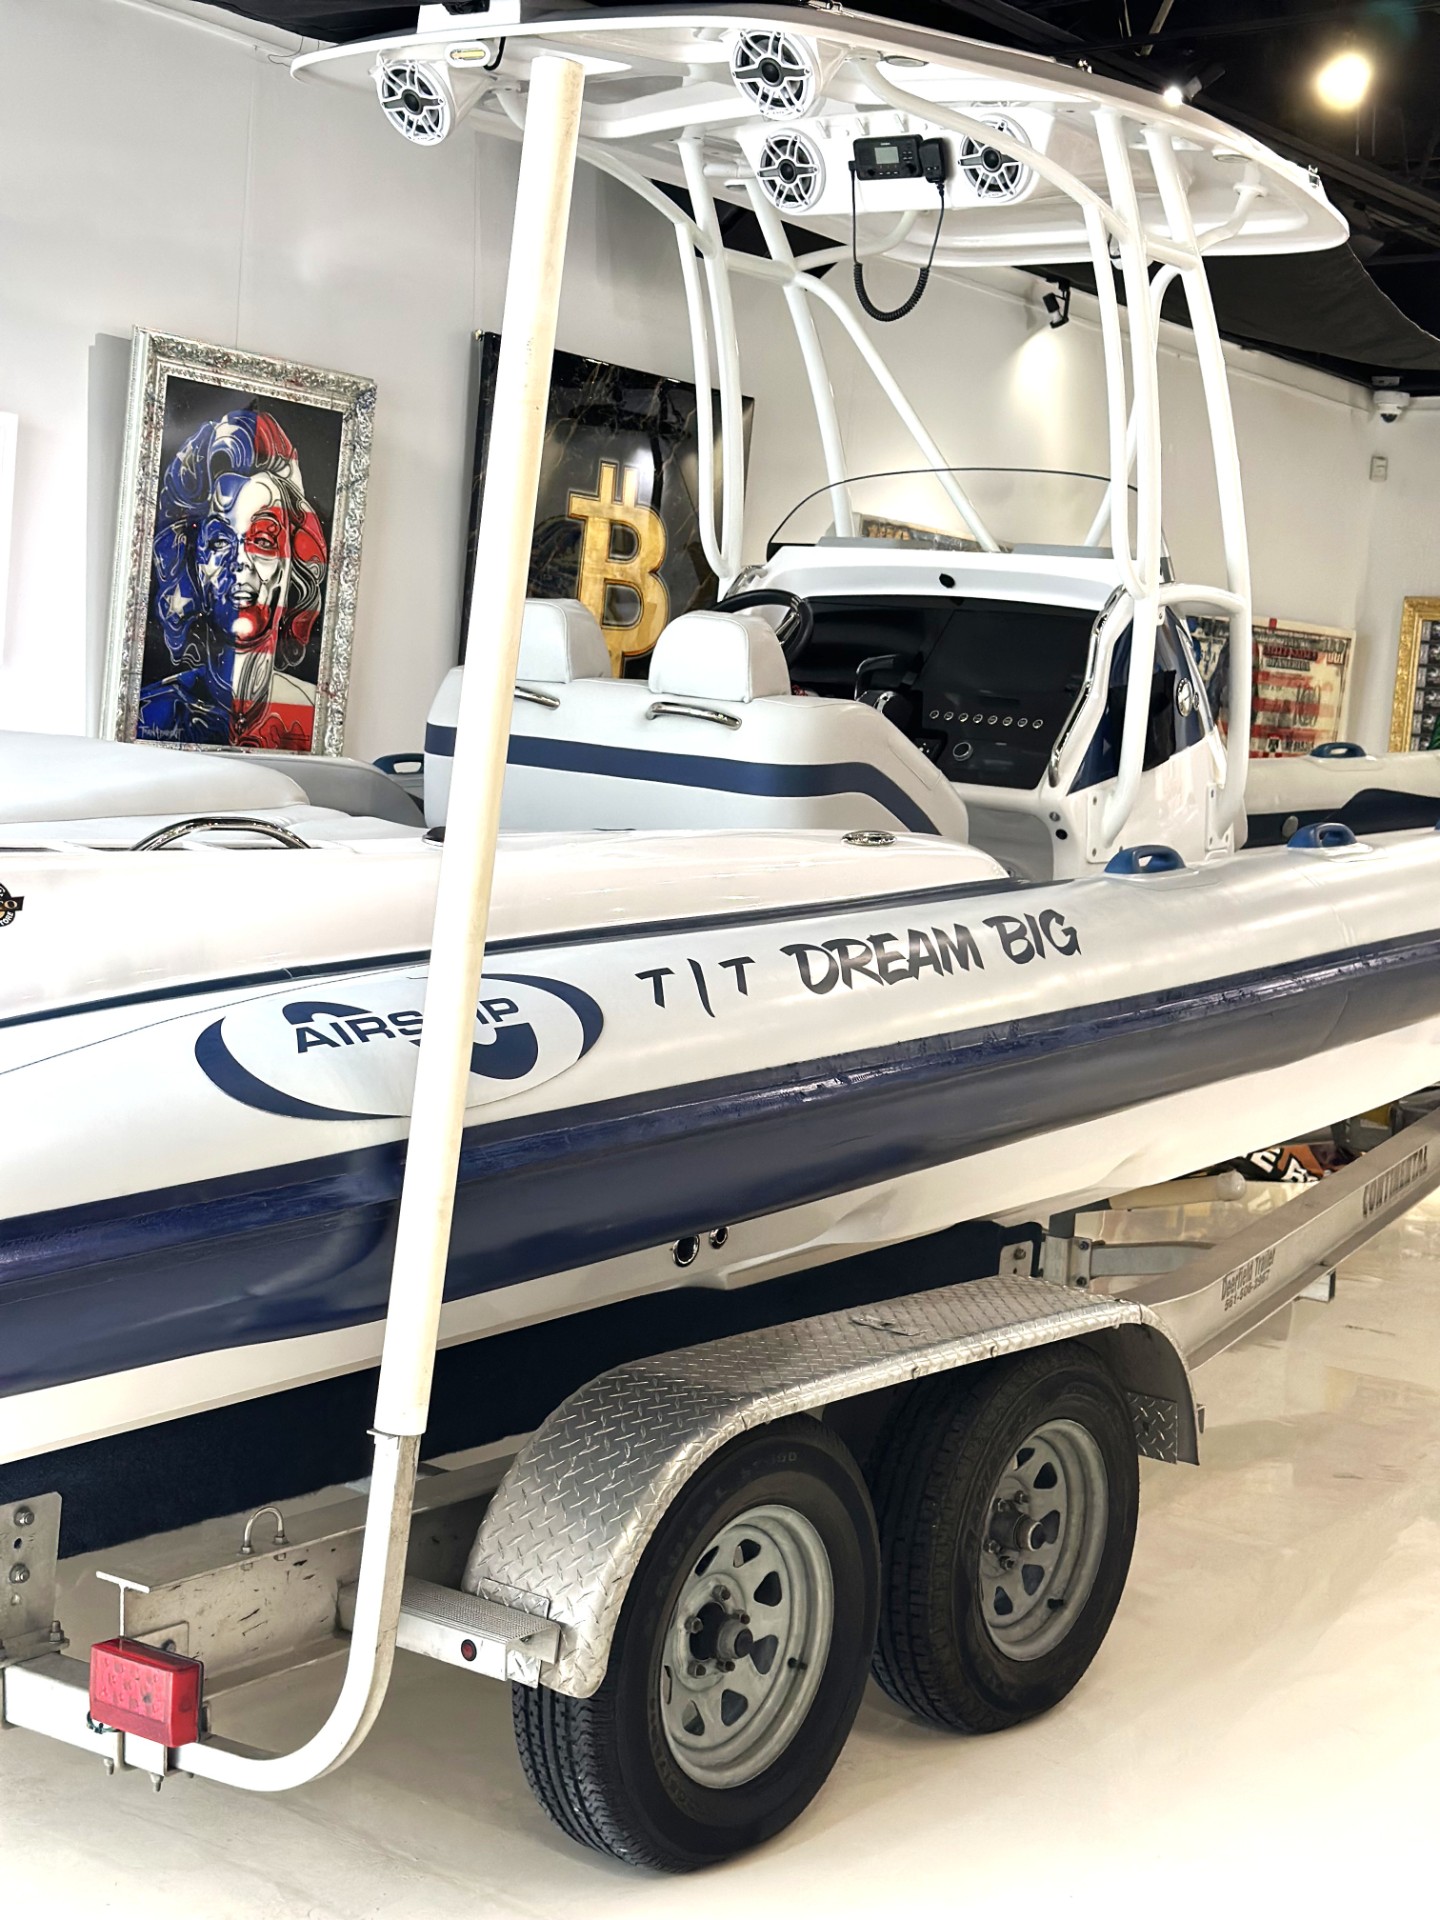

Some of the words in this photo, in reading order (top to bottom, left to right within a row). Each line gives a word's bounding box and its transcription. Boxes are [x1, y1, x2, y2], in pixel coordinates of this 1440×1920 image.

[780, 923, 984, 995] DREAM
[982, 908, 1082, 965] BIG
[296, 997, 519, 1054] AIRSIP
